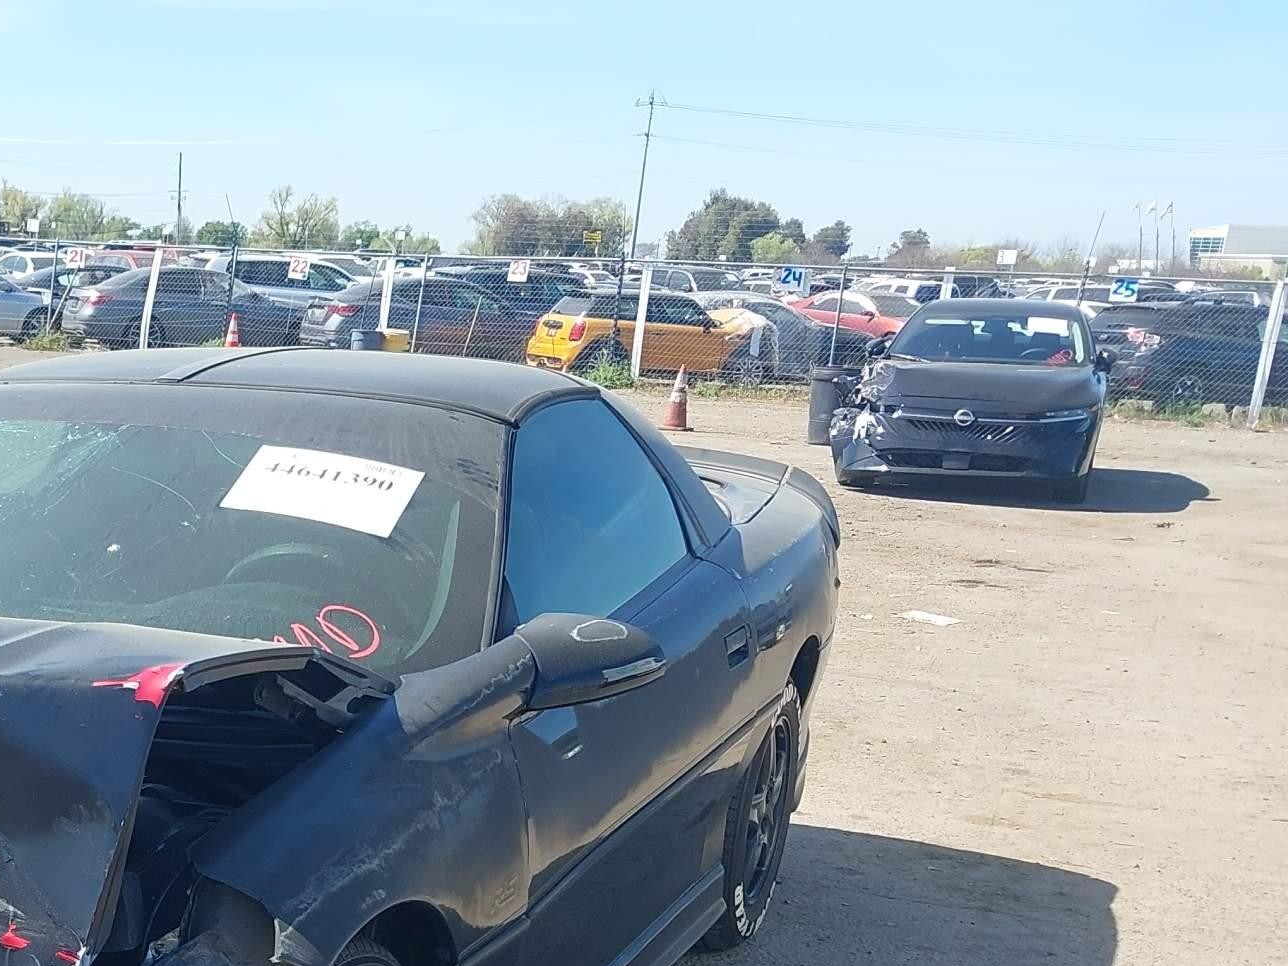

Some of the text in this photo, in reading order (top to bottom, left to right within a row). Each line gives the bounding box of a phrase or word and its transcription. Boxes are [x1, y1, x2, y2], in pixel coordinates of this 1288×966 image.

[69, 249, 84, 263] 21
[291, 259, 308, 273] 22
[510, 260, 528, 275] 23
[781, 268, 803, 287] 24
[1112, 278, 1139, 298] 25
